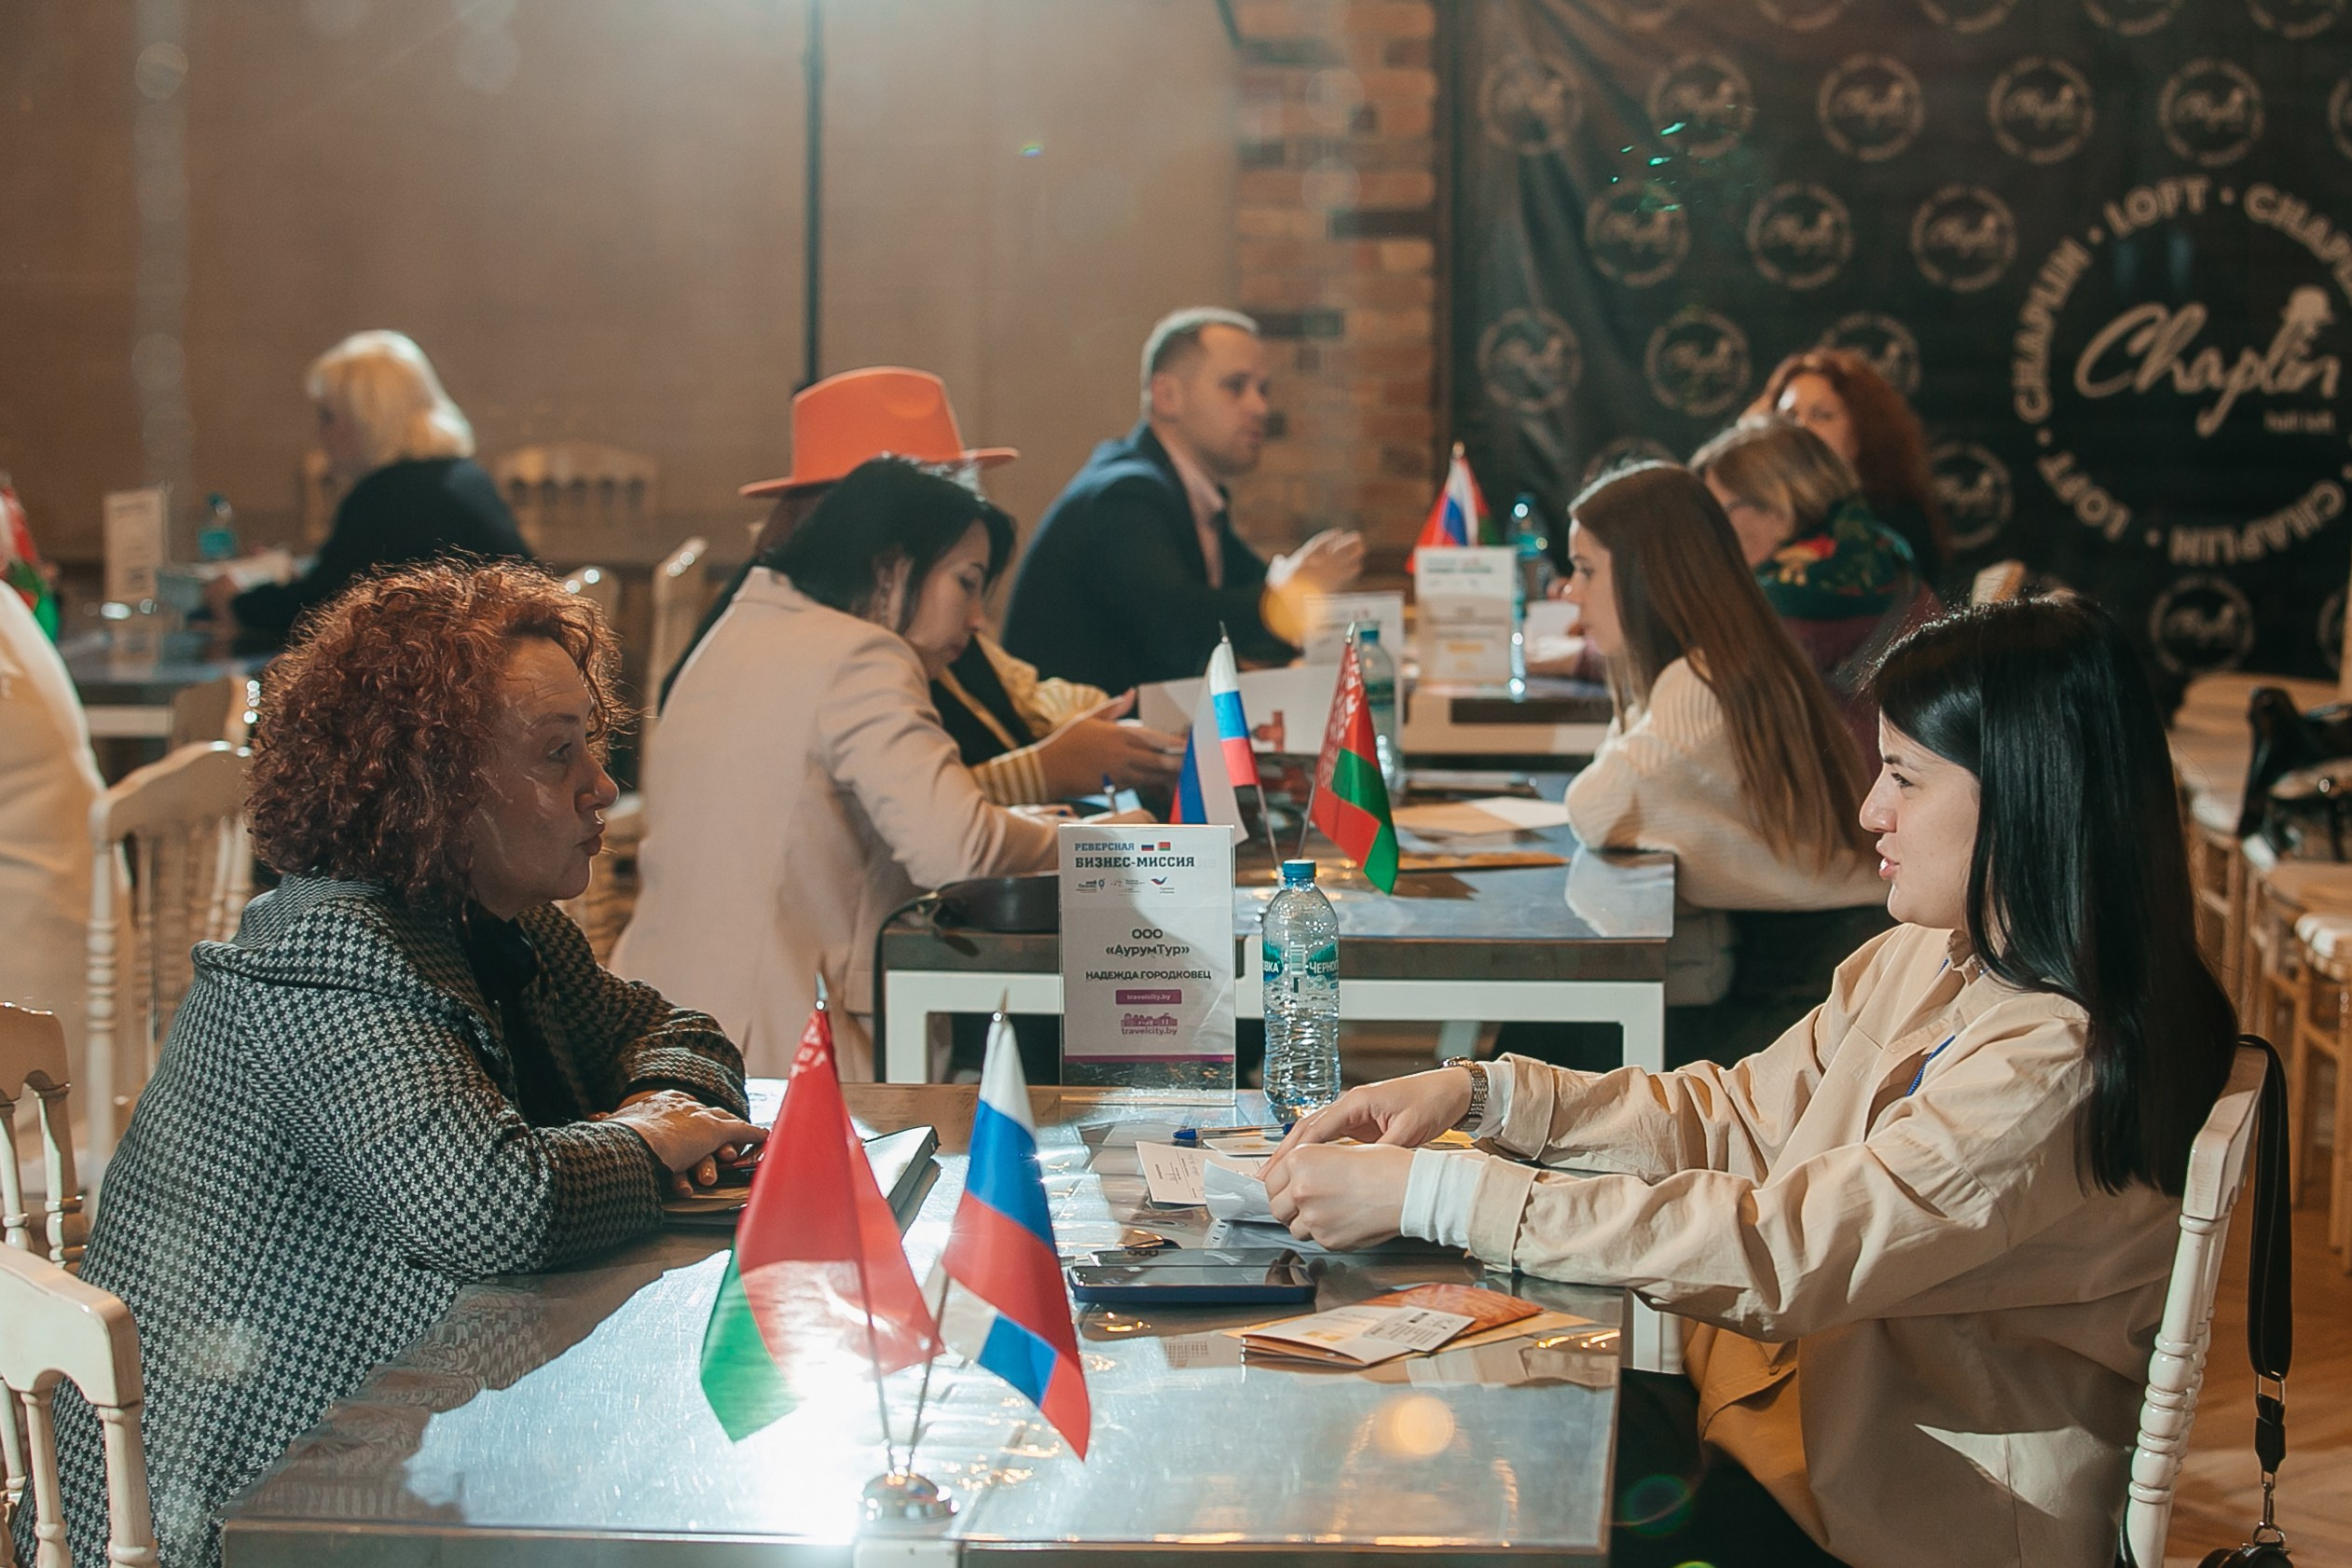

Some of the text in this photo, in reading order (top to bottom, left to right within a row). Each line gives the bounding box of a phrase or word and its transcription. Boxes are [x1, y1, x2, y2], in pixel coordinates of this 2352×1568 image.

[2103, 174, 2211, 238] LOFT
[2073, 299, 2342, 439] Chaplin
[1075, 842, 1135, 852] РЕВЕРСНАЯ
[1075, 857, 1195, 869] БИЗНЕС-МИССИЯ
[1131, 928, 1163, 940] ООО
[1106, 943, 1190, 957] «АурумТур»
[1085, 970, 1212, 981] НАДЕЖДА ГОРОДКОВЕЦ
[1126, 993, 1172, 1001] travelcity.by
[1121, 1026, 1178, 1037] travelcity.by
